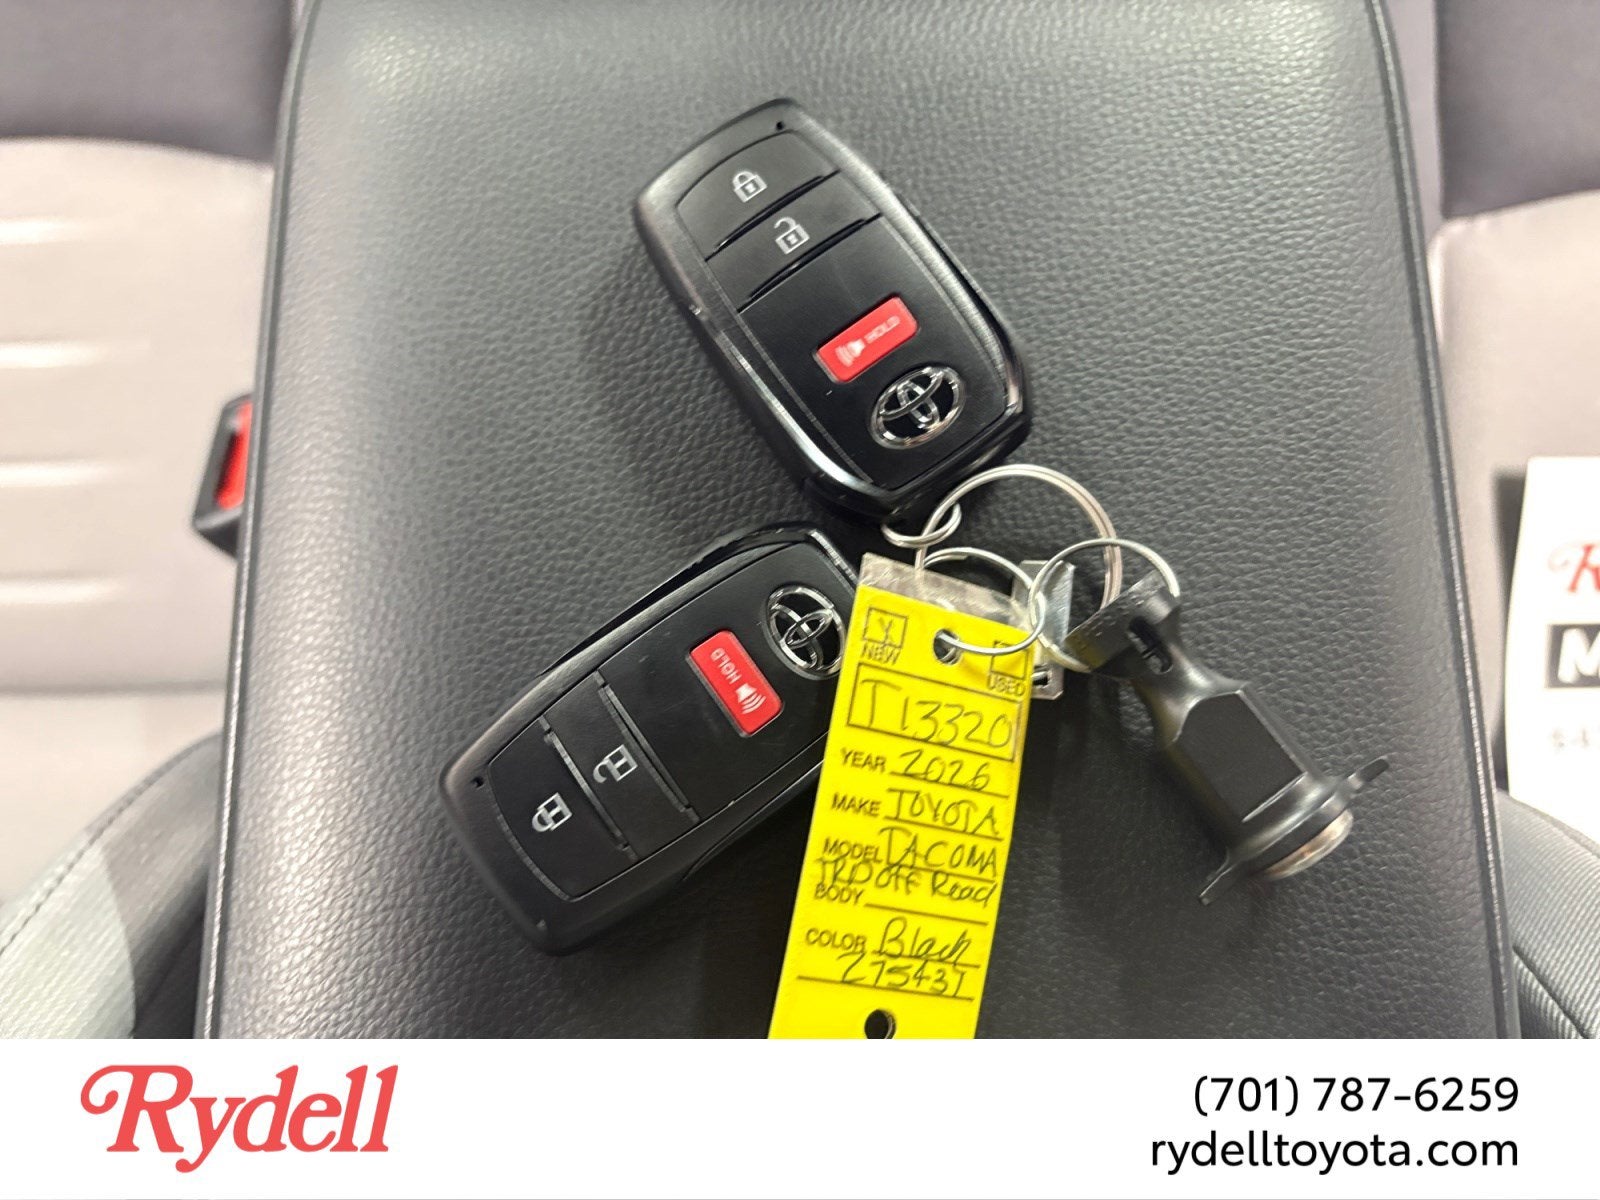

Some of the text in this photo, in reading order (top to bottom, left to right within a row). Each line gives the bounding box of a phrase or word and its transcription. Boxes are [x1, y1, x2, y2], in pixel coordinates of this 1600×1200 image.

[864, 316, 900, 344] HOLD
[710, 647, 742, 685] HOLD
[862, 645, 900, 665] NEW
[987, 675, 1026, 697] USED
[840, 748, 887, 772] YEAR
[899, 749, 992, 791] 2026
[831, 793, 882, 818] MAKE
[886, 788, 1000, 836] TOYOTA
[822, 837, 883, 864] MODEL
[878, 826, 998, 877] TACOMA
[816, 857, 874, 886] TRD
[814, 883, 864, 905] BODY
[805, 927, 868, 953] COLOR
[877, 916, 972, 967] Black
